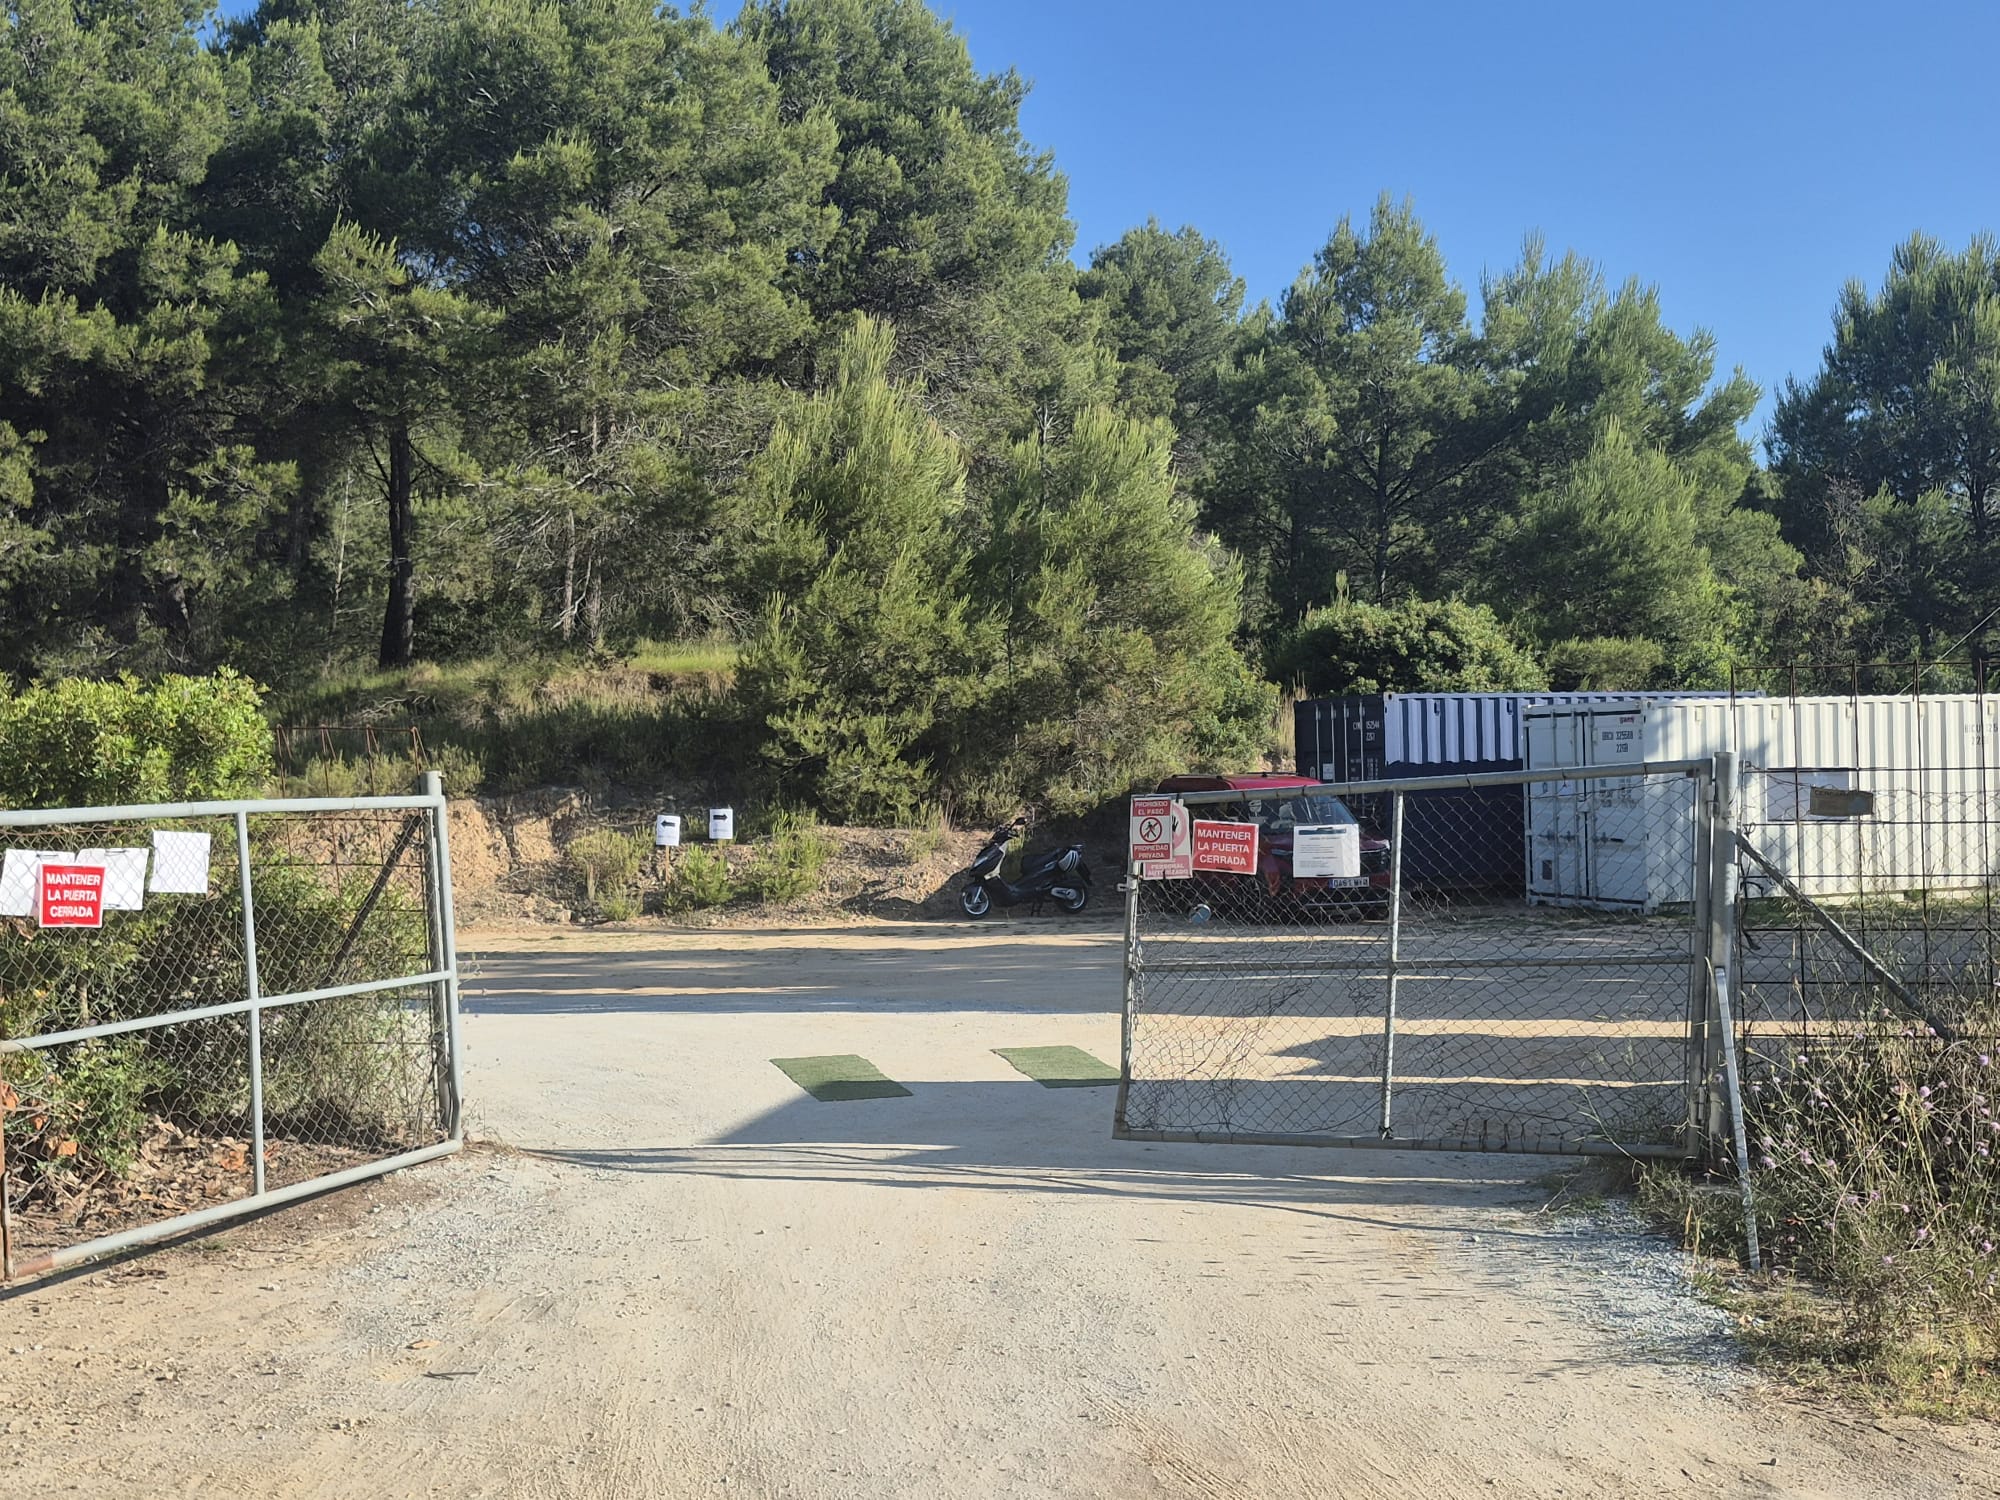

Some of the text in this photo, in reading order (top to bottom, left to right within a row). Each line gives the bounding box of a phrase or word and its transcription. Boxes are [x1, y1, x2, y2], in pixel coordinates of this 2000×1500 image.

[1197, 829, 1251, 841] MANTENER
[1197, 842, 1250, 853] LA PUERTA
[1199, 854, 1247, 866] CERRADA
[46, 872, 101, 886] MANTENER
[47, 889, 98, 902] LA PUERTA
[49, 905, 94, 918] CERRADA
